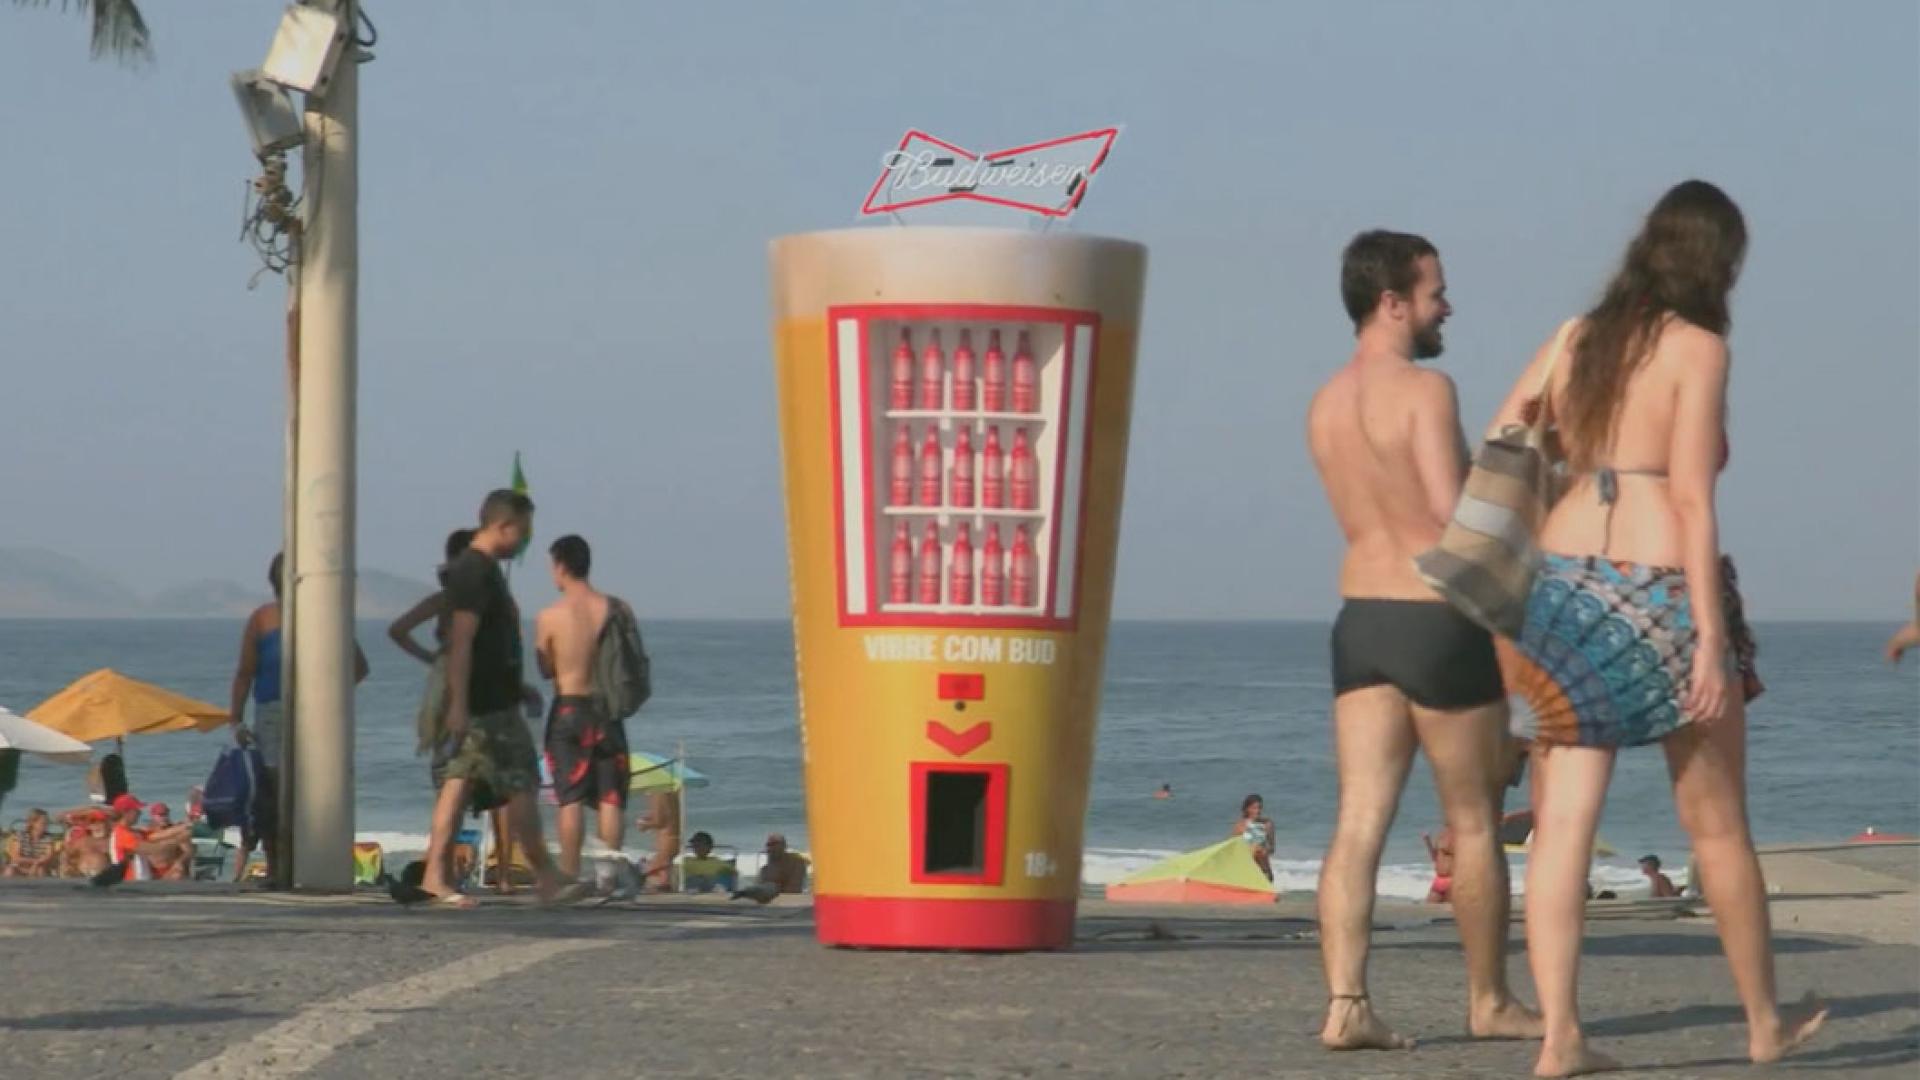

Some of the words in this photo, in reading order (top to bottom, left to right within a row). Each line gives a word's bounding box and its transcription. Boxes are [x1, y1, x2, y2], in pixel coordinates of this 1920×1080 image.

[883, 150, 1087, 190] Budweiser
[864, 634, 936, 661] VIBRE
[943, 635, 1002, 662] COM
[1009, 637, 1056, 664] BUD
